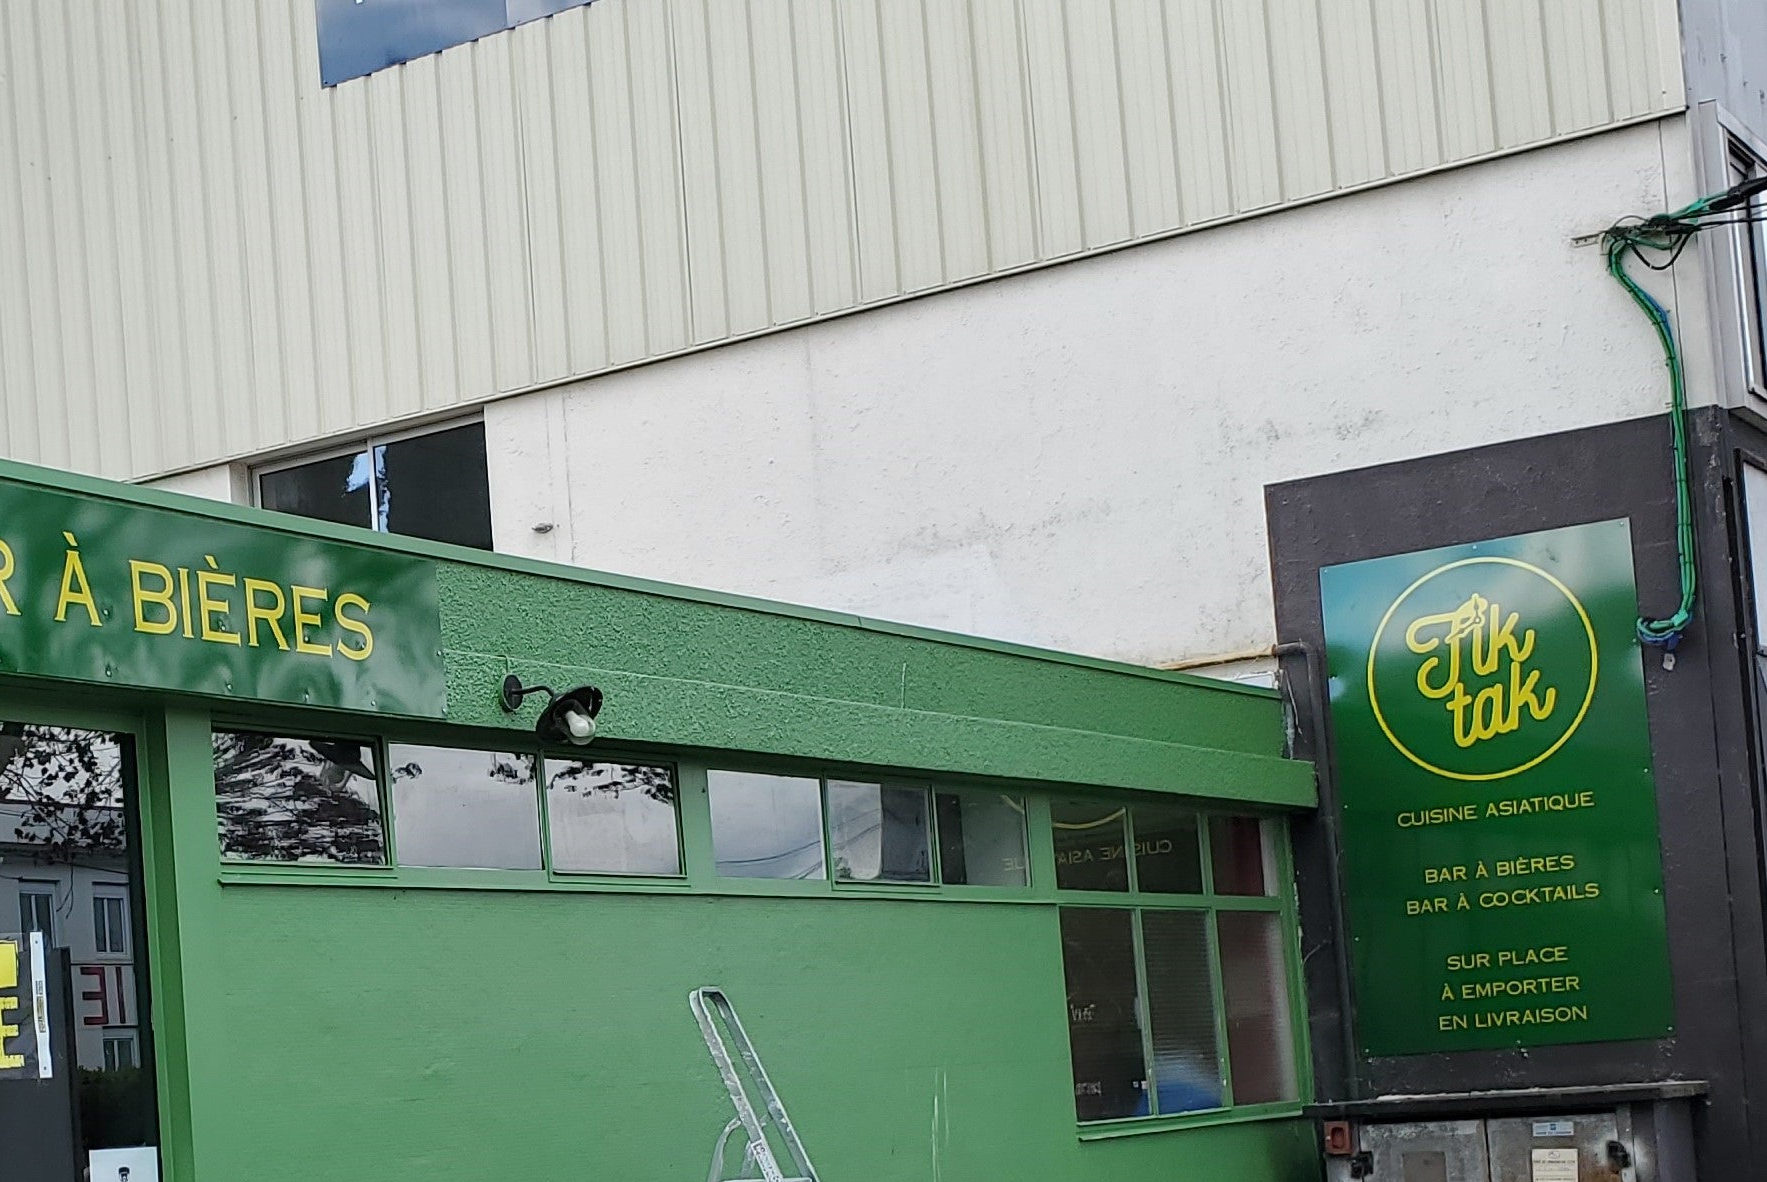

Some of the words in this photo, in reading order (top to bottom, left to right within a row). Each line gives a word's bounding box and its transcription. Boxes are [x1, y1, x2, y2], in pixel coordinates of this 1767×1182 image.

[54, 531, 103, 627] À
[128, 554, 375, 662] BIÈRES
[1445, 661, 1557, 749] tak
[1397, 804, 1478, 828] CUISINE
[1484, 791, 1596, 818] ASIATIQUE
[1424, 864, 1467, 885] BAR
[1475, 859, 1489, 879] À
[1495, 854, 1575, 878] BIÈRES
[1406, 896, 1449, 916] BAR
[1456, 890, 1471, 911] À
[1478, 883, 1600, 909] COCKTAILS
[1446, 951, 1491, 972] SUR
[1497, 945, 1569, 967] PLACE
[1440, 979, 1456, 1002] À
[1461, 974, 1581, 999] EMPORTER
[1438, 1011, 1470, 1031] EN
[1475, 1004, 1588, 1029] LIVRAISON
